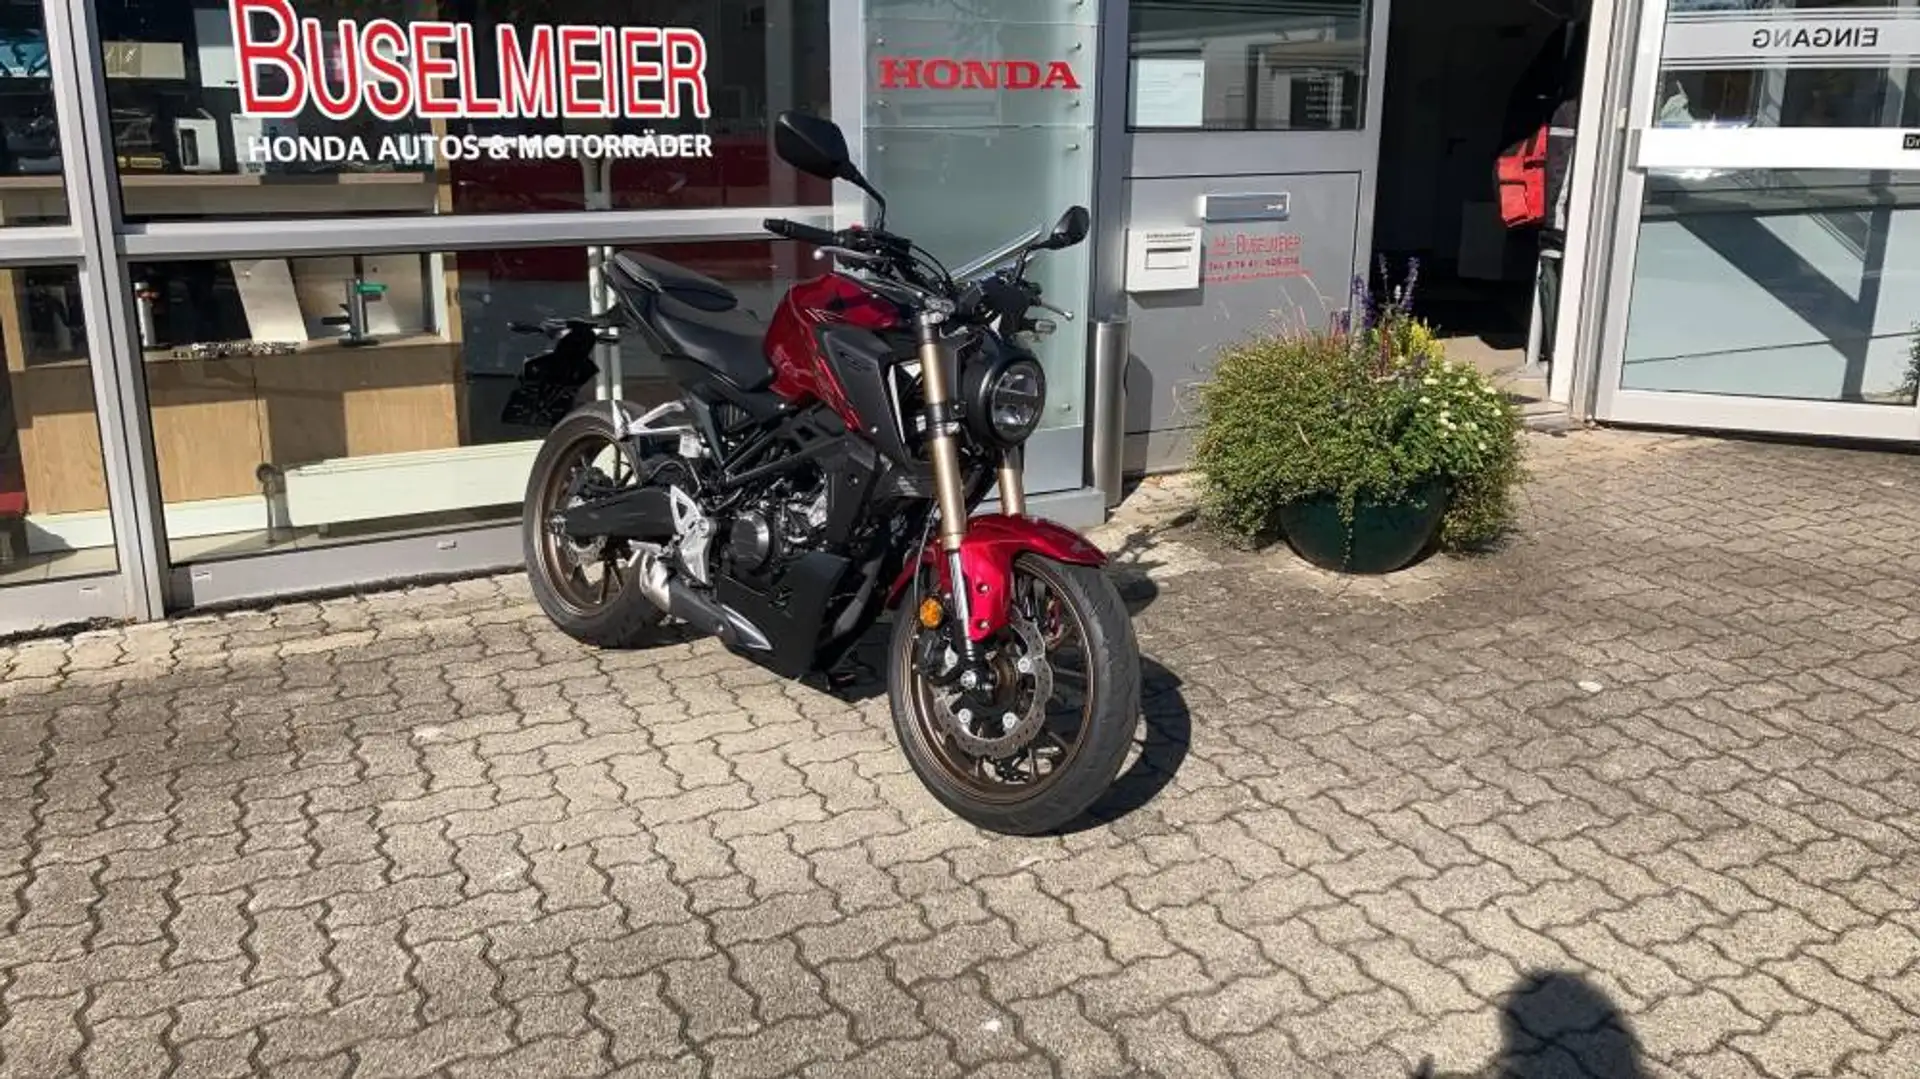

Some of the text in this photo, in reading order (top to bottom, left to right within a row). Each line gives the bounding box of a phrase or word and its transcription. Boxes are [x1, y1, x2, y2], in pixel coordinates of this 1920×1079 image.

[229, 0, 711, 119] BUSELMEIER
[878, 58, 1083, 90] HONDA
[249, 129, 713, 162] HONDA AUTOS & MOTORRÄDER
